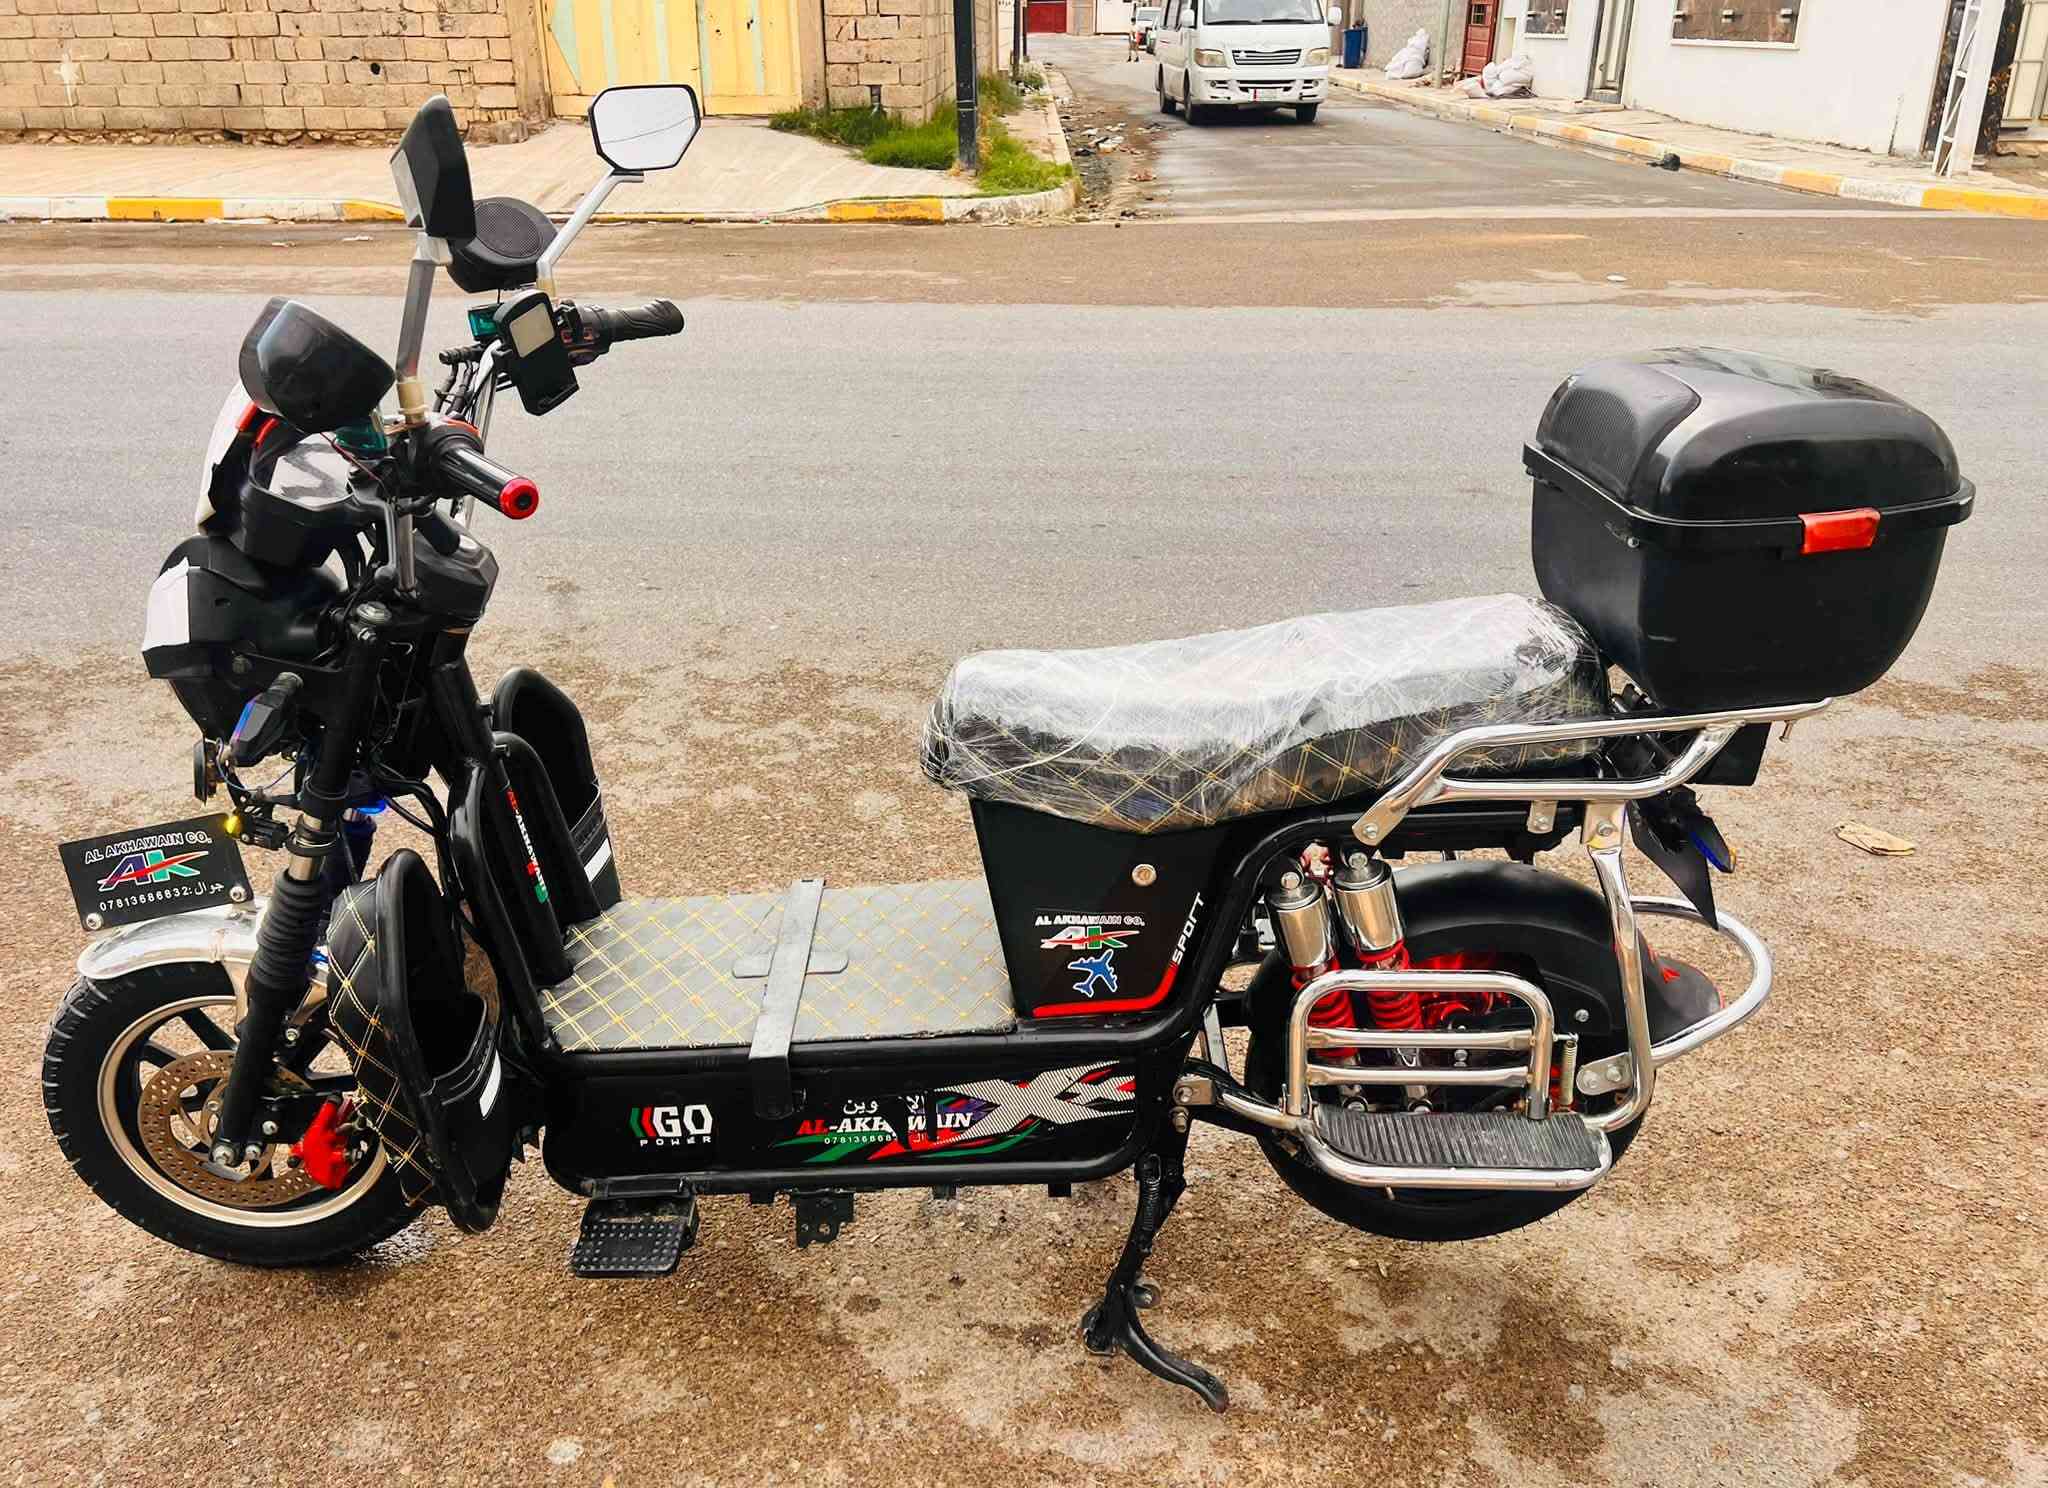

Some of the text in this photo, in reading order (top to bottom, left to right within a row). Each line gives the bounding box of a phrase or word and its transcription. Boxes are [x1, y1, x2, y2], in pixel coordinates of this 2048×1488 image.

[85, 830, 213, 864] AL AKHAWAIN CO.
[97, 849, 209, 892] AK
[1034, 915, 1052, 926] AL
[1053, 914, 1122, 926] AKHAWAIN
[1171, 891, 1205, 966] SPORT
[652, 1103, 713, 1138] GO
[640, 1135, 712, 1148] POWER
